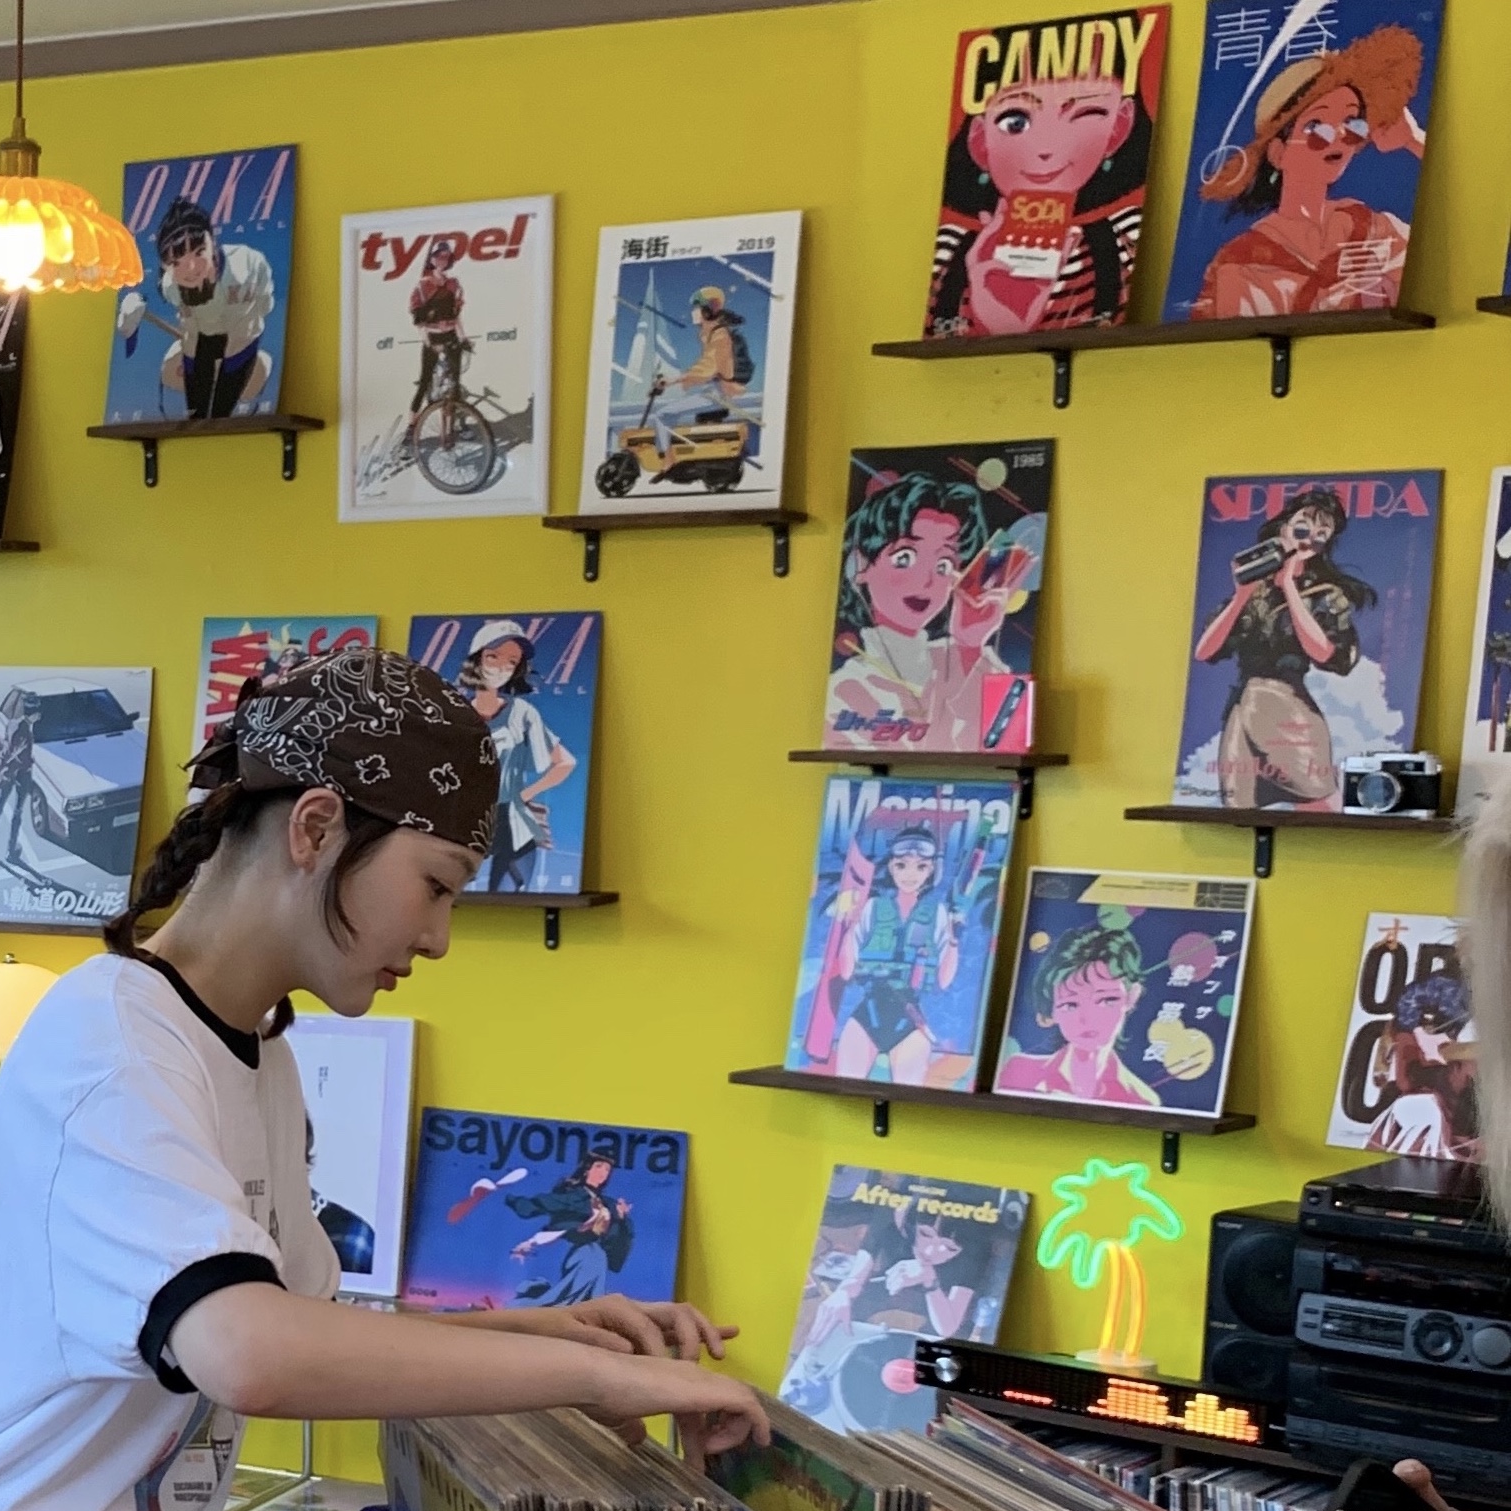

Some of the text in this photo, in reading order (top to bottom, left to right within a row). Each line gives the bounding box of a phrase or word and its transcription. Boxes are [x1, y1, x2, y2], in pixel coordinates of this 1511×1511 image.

[1212, 0, 1339, 70] 青春
[961, 13, 1158, 115] CANDY
[1011, 197, 1066, 224] SODA
[361, 214, 530, 281] type!
[621, 236, 669, 260] 海街
[737, 237, 775, 251] 2019
[423, 1112, 679, 1175] sayonara
[851, 1183, 913, 1210] After
[916, 1196, 1003, 1224] records
